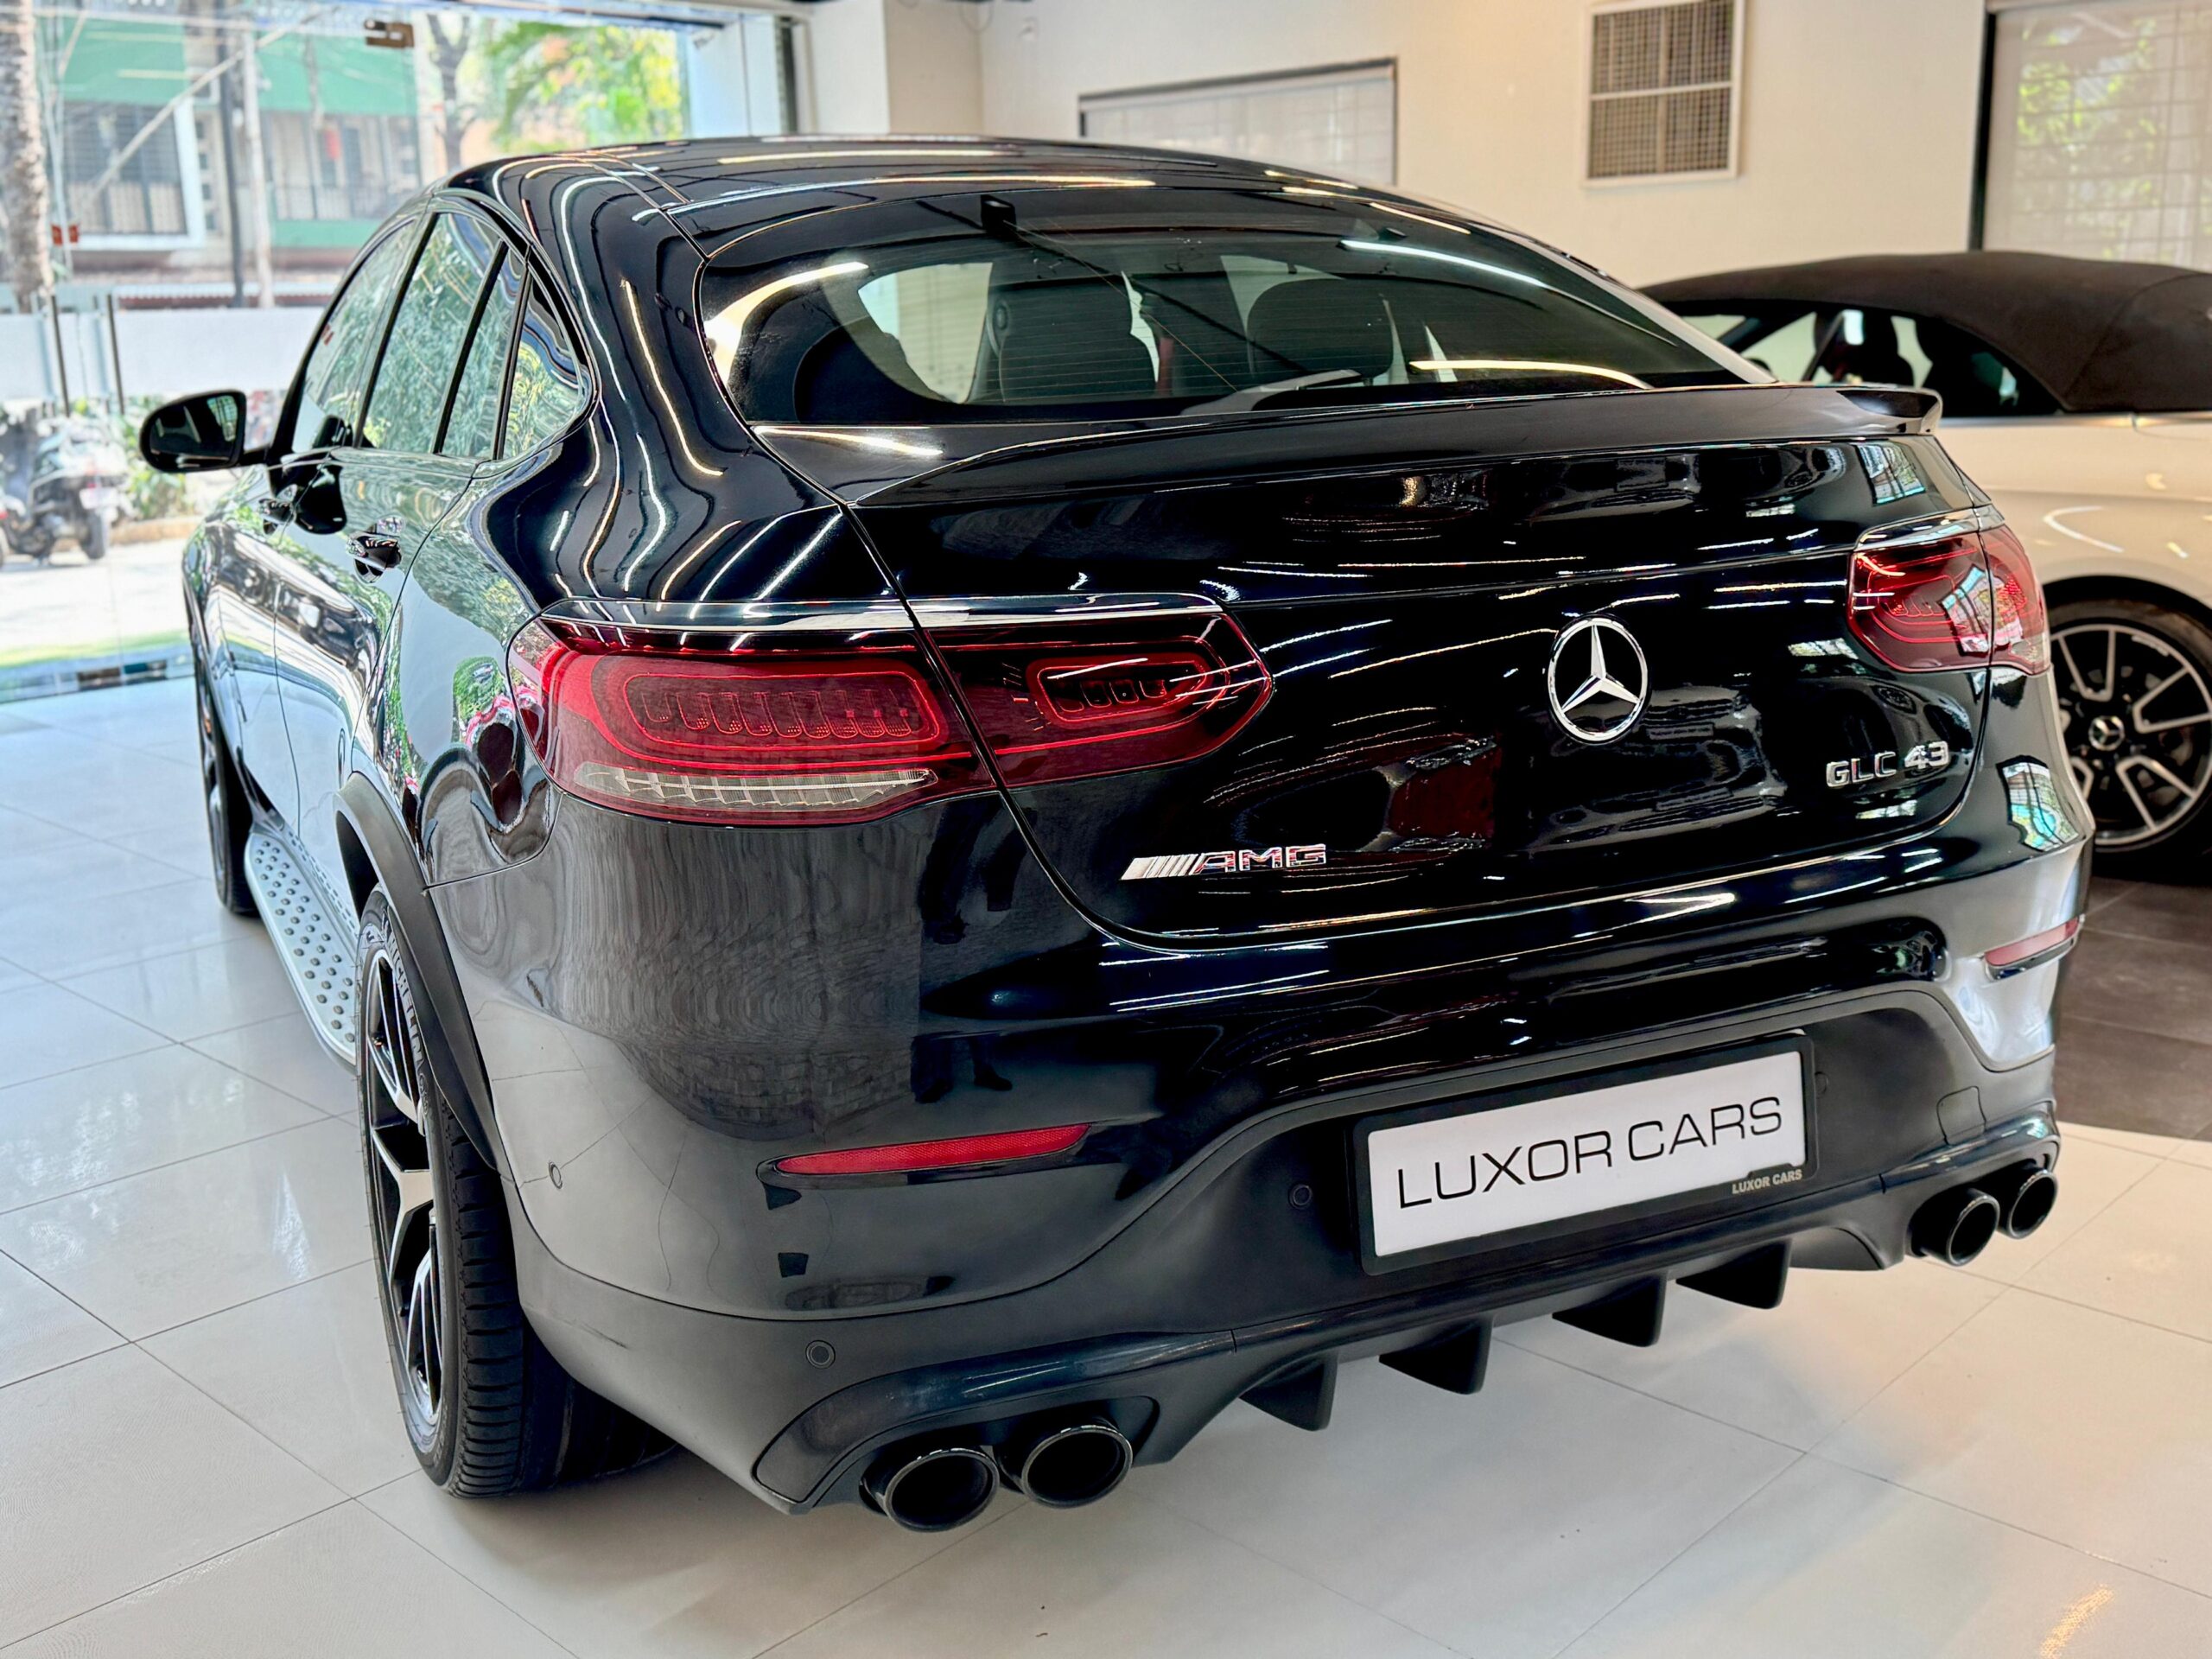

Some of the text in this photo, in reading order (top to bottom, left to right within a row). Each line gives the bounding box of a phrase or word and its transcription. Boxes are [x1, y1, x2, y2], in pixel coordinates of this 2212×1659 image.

[1826, 741, 1949, 787] GLC 43
[1189, 843, 1326, 875] AMG
[1397, 1096, 1782, 1209] LUXOR CARS
[1732, 1169, 1802, 1194] LUXOR CARS
